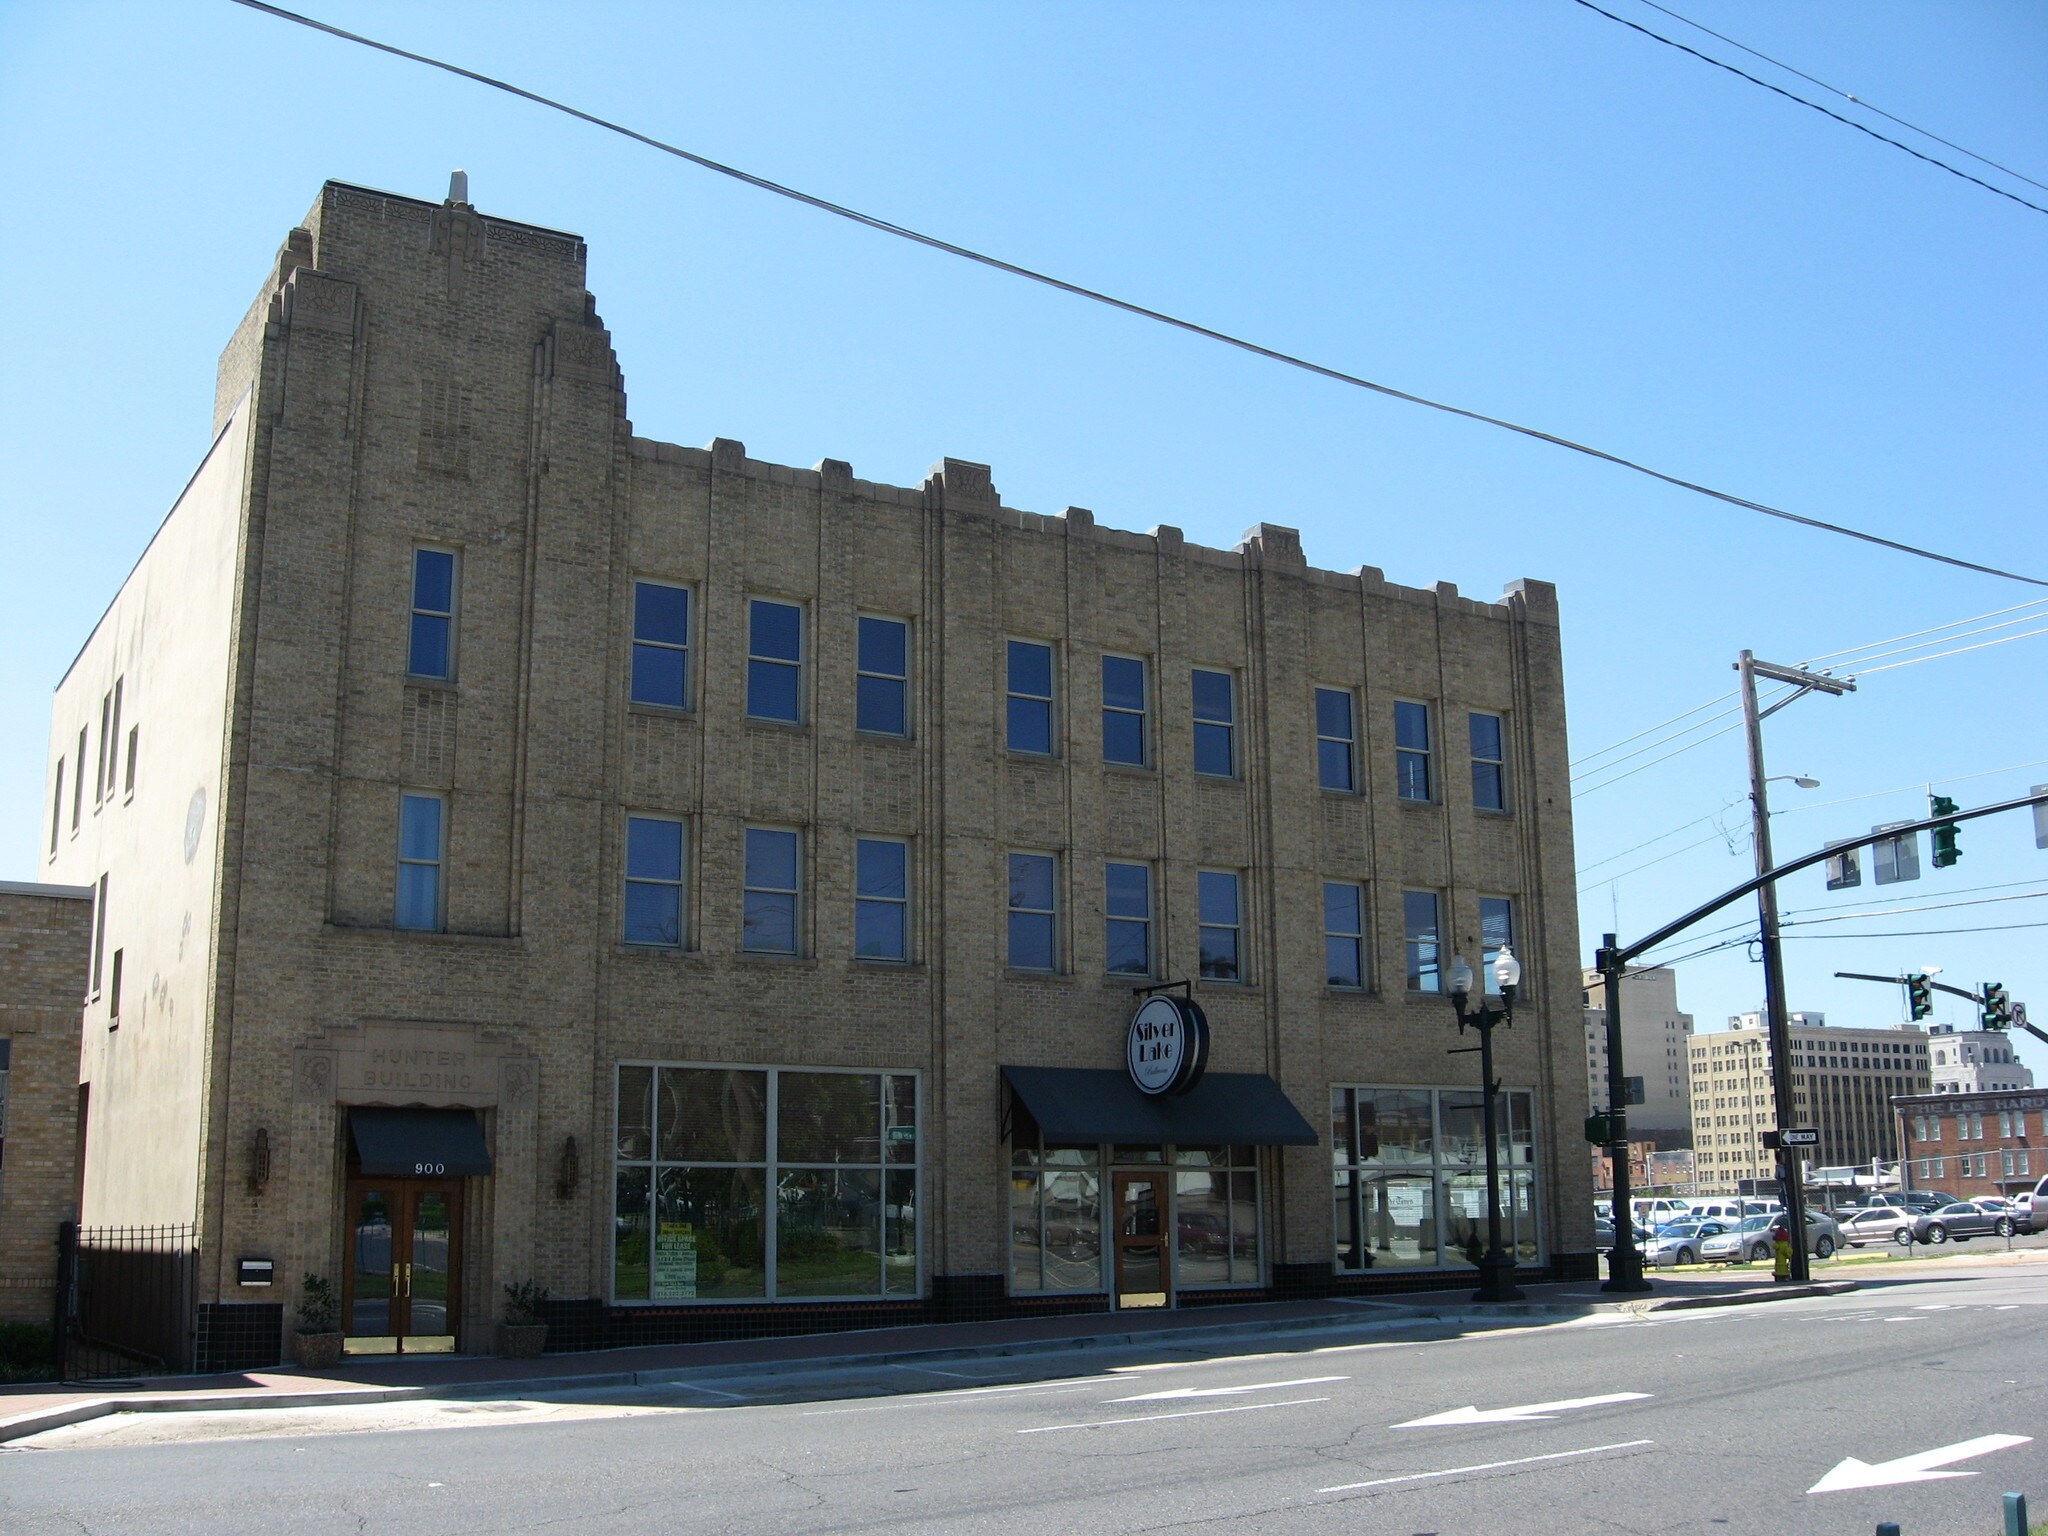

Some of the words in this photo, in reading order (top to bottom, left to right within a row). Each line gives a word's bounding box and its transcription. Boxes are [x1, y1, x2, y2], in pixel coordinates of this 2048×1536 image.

[1135, 1022, 1175, 1042] Silver
[372, 1048, 466, 1067] HUNTER
[1139, 1041, 1173, 1062] Lake
[363, 1070, 472, 1089] BUILDING
[1790, 1133, 1799, 1141] ONE
[415, 1163, 445, 1175] 900
[661, 1242, 673, 1250] FOR
[673, 1242, 691, 1250] LEASE
[677, 1235, 697, 1243] SPACE
